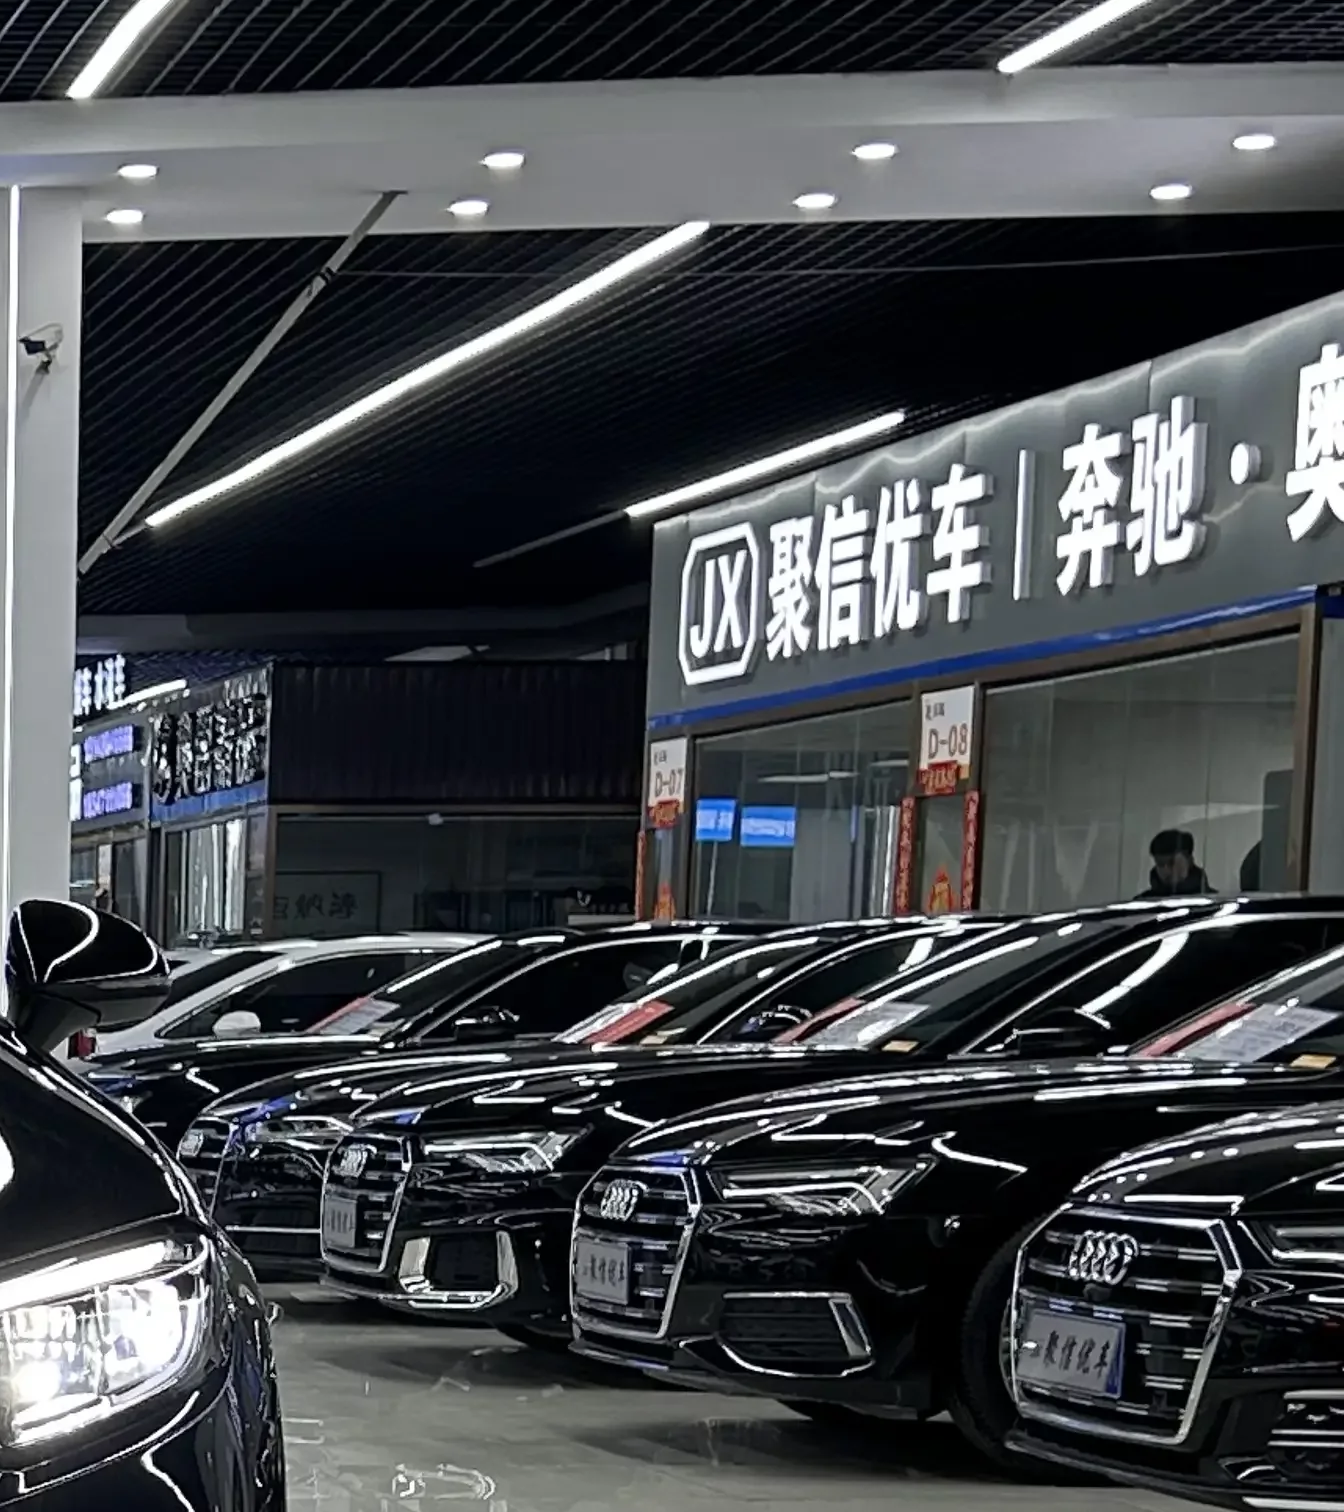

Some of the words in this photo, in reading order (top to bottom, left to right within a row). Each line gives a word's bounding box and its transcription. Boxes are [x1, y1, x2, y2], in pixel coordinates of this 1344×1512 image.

[689, 548, 749, 660] JX
[765, 463, 990, 662] 聚信优车
